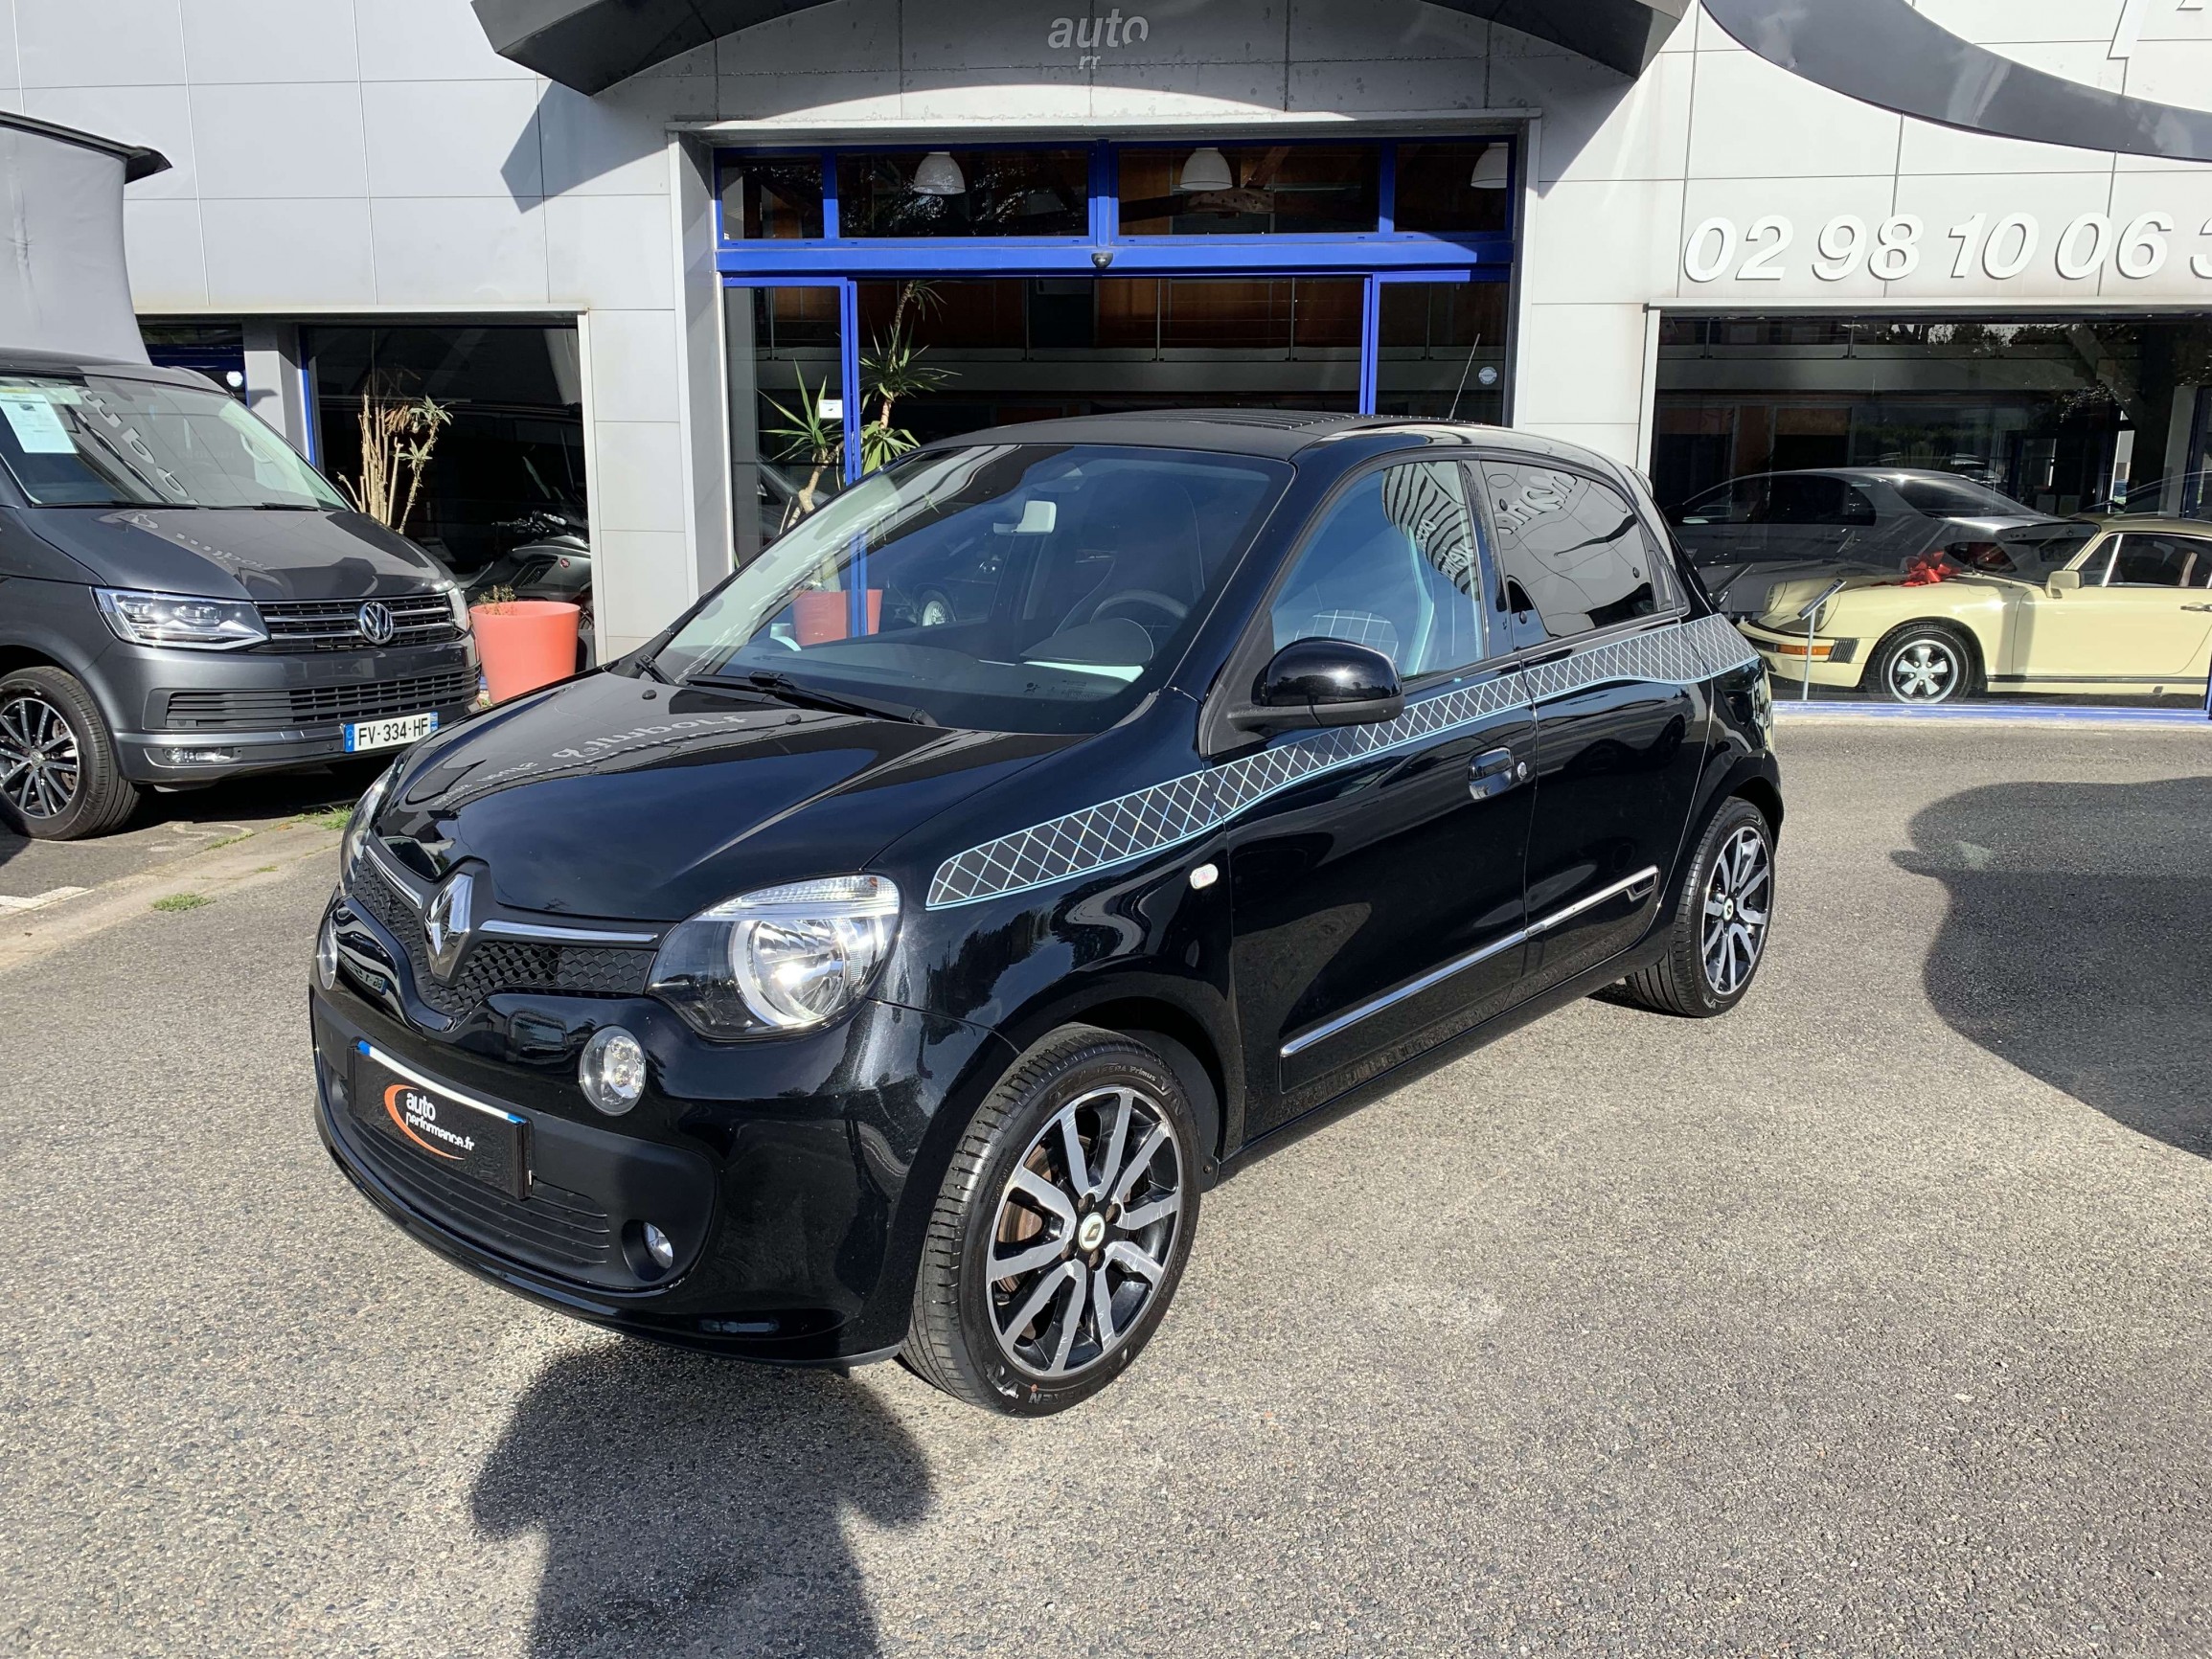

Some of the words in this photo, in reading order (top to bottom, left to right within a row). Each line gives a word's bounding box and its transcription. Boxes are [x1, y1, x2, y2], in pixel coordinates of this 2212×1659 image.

[1048, 9, 1149, 49] auto
[1683, 216, 1793, 283] 02
[1812, 214, 1924, 282] 98
[1949, 212, 2040, 280] 10
[2055, 211, 2175, 280] 06
[358, 717, 428, 746] FV-334-HF
[1129, 1065, 1157, 1081] Primus
[406, 1092, 436, 1121] auto
[406, 1112, 475, 1150] performance.fr
